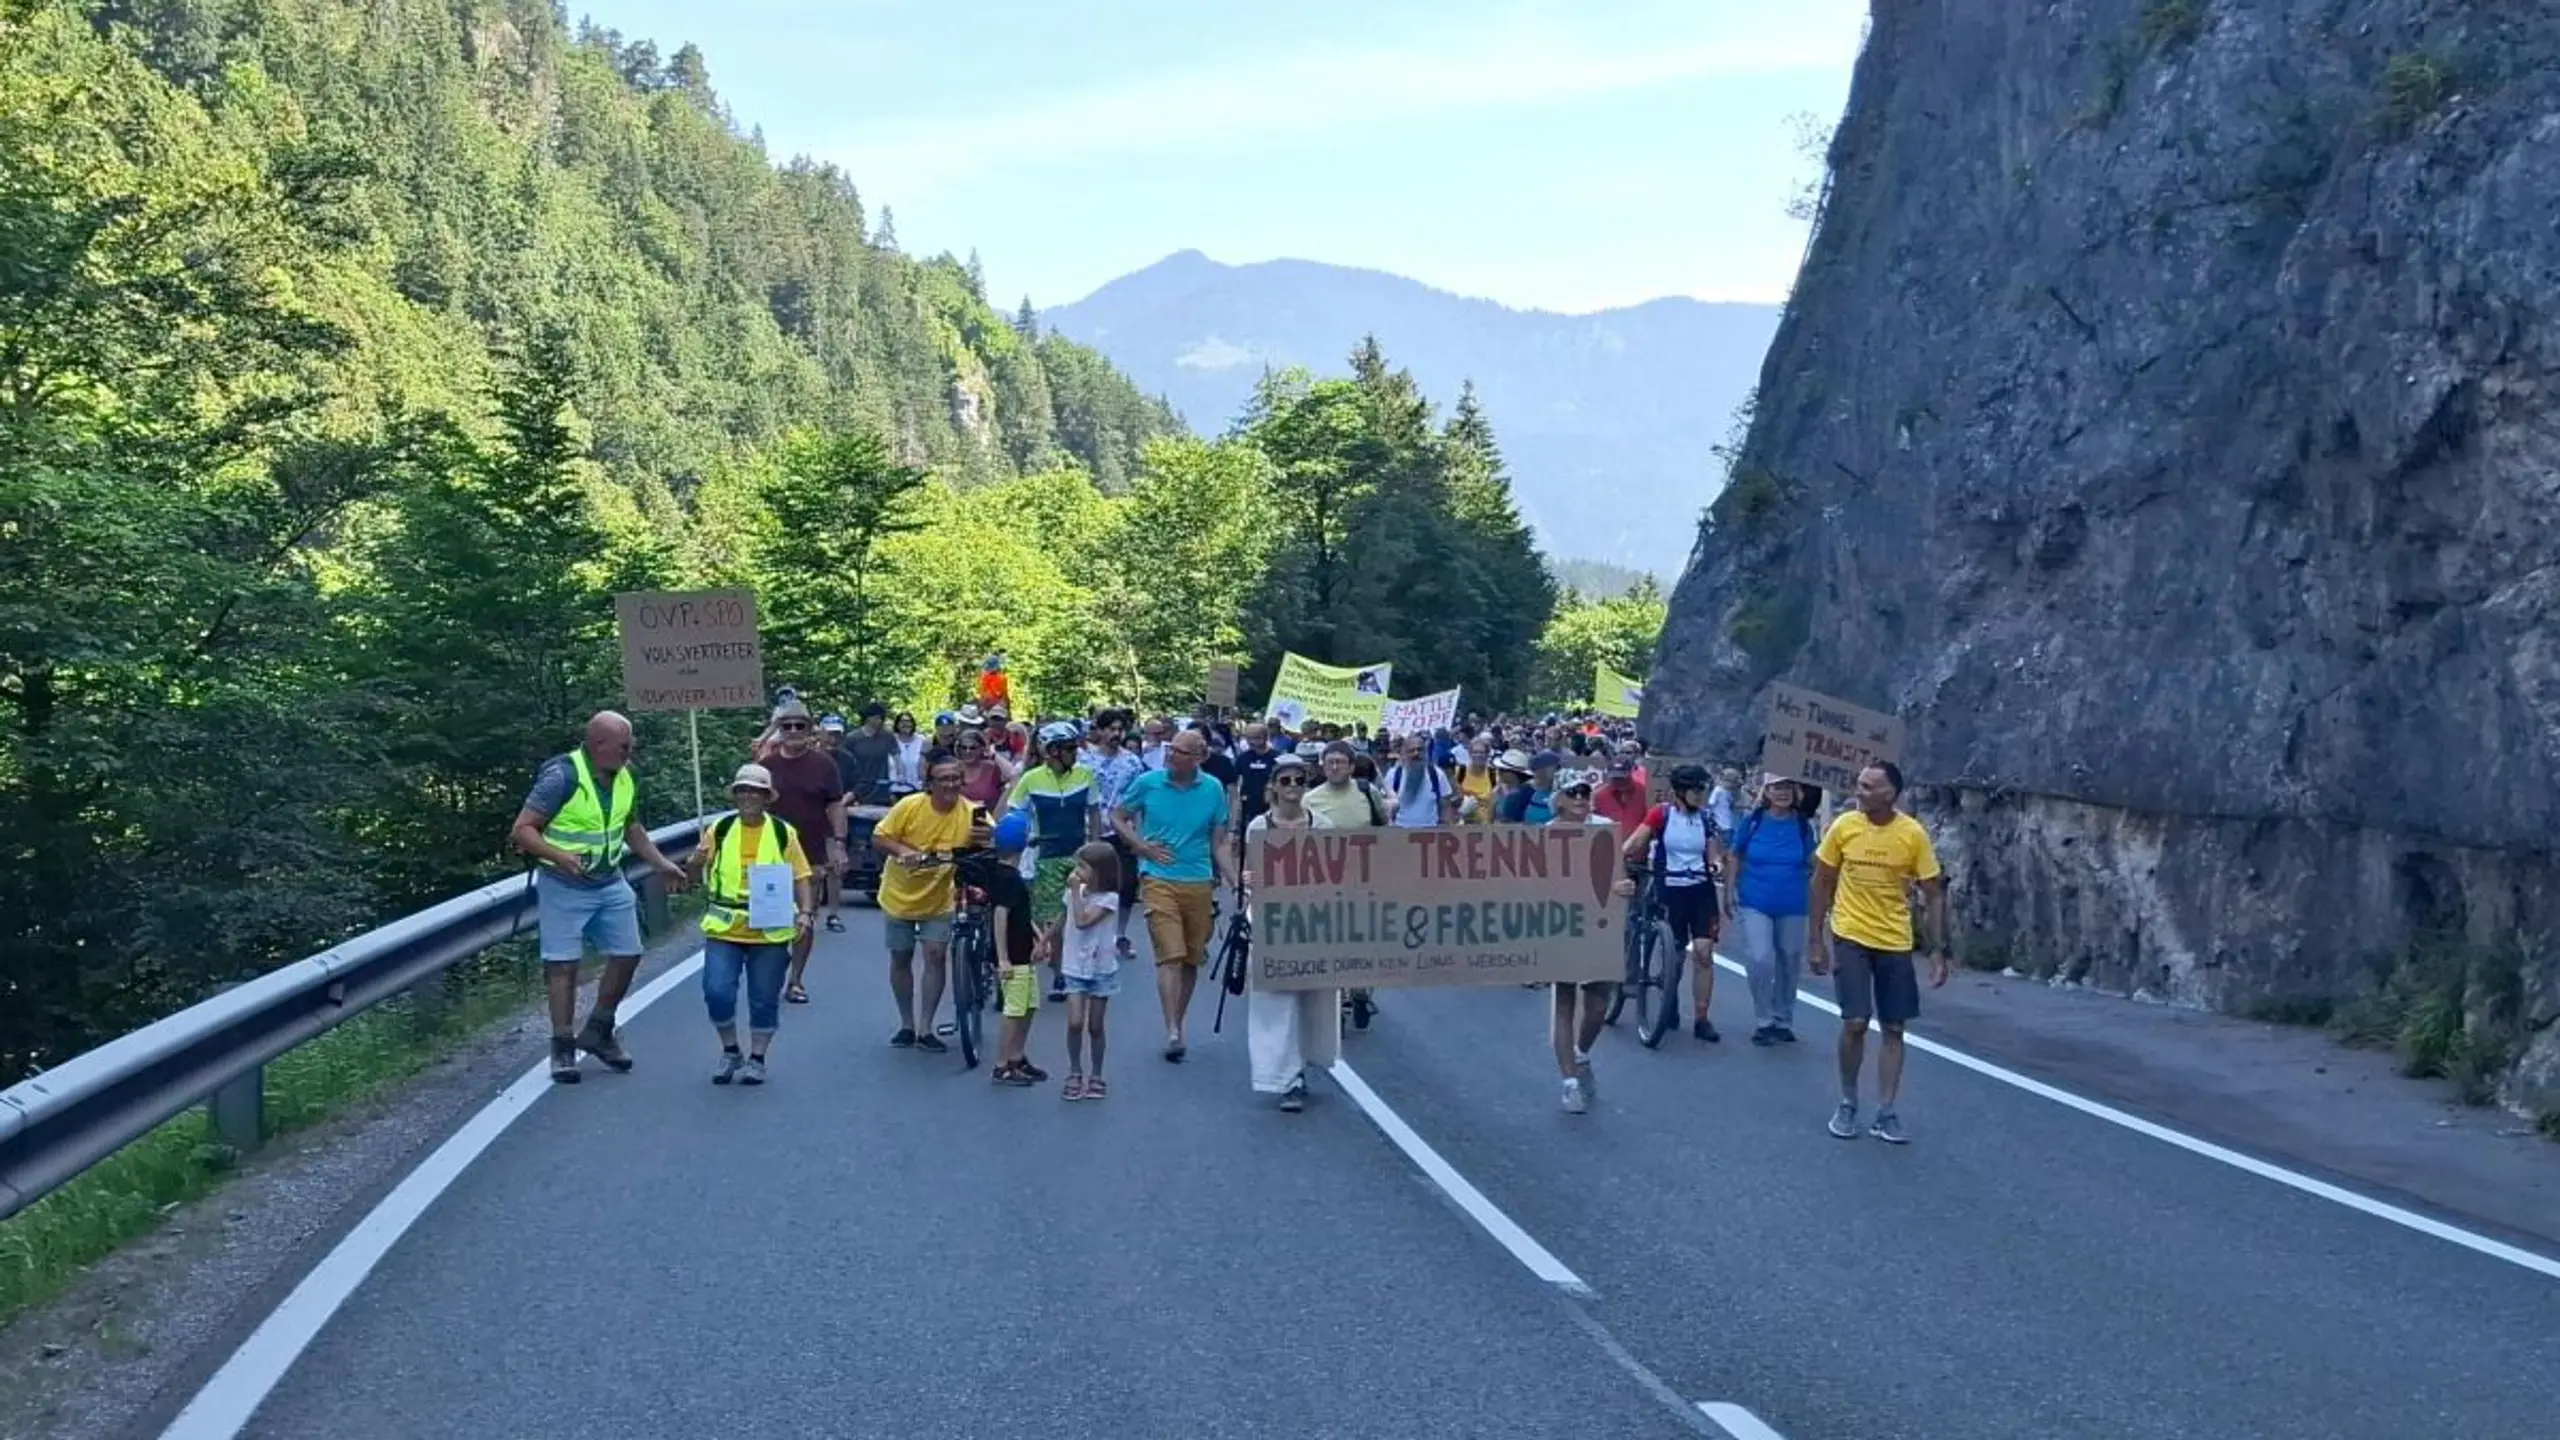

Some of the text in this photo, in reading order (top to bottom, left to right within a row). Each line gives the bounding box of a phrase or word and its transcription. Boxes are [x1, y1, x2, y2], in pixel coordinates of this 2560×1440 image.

[642, 641, 756, 666] VOLKSVERTRETER
[1263, 833, 1379, 888] MAUT
[1408, 827, 1585, 881] TRENNT
[1403, 904, 1430, 949] &
[1435, 900, 1587, 946] FREUNDE
